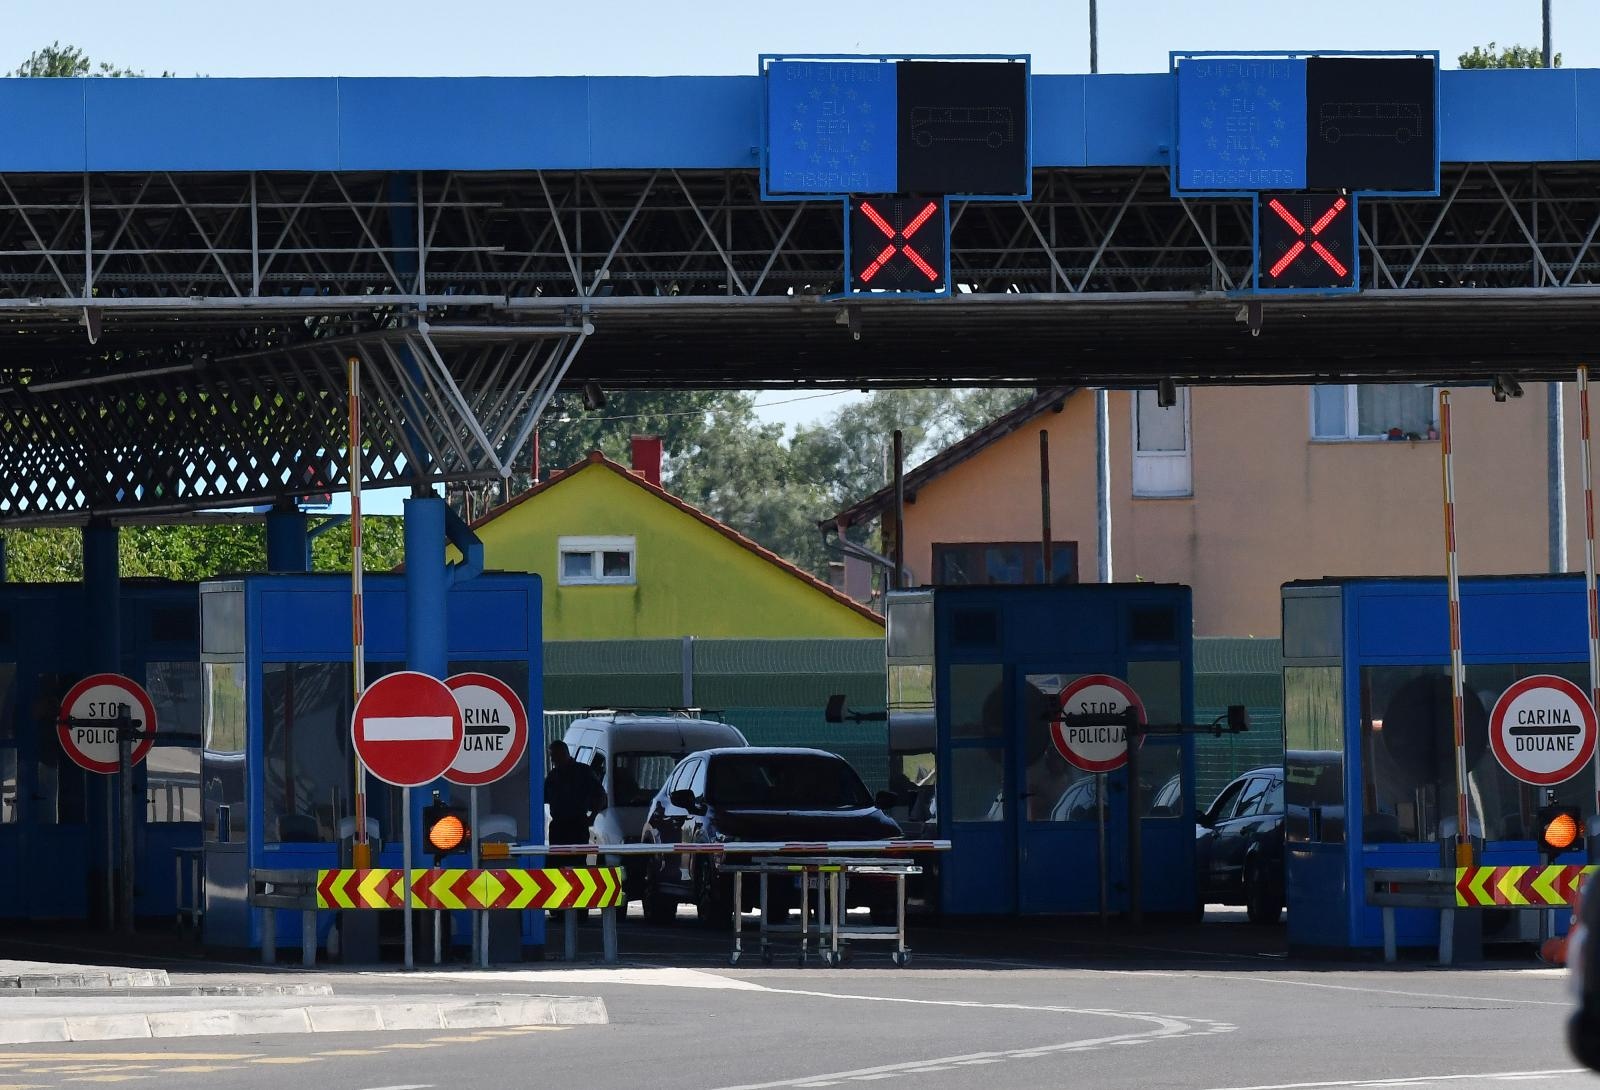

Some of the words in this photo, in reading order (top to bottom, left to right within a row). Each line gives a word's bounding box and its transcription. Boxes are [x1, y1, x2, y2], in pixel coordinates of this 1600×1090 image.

[1231, 97, 1256, 113] EU
[89, 702, 124, 718] STO
[464, 708, 500, 724] RINA
[1080, 702, 1117, 716] STOP
[1518, 709, 1572, 724] CARINA
[77, 729, 137, 744] POLICI
[1070, 728, 1128, 743] POLICIJA
[463, 736, 504, 752] UANE
[1516, 736, 1575, 752] DOUANE
